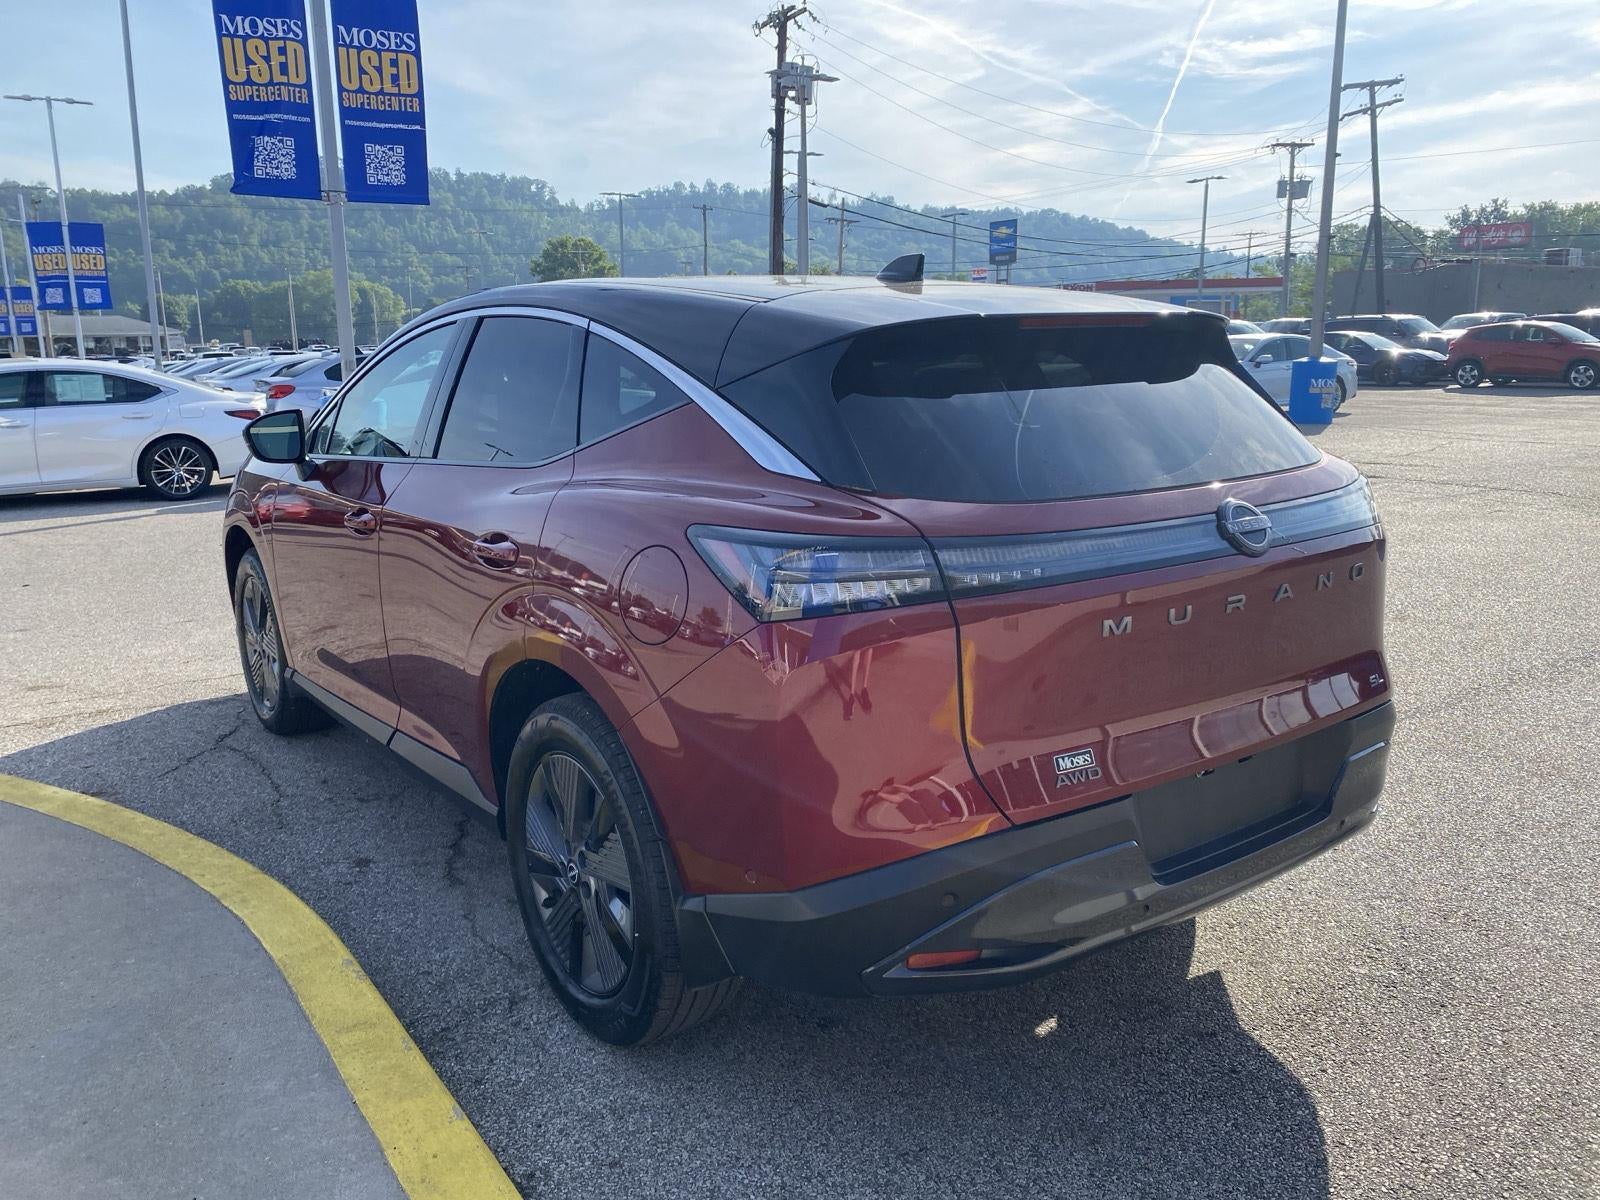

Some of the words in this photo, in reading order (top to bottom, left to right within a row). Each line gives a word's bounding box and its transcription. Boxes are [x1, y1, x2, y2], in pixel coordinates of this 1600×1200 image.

[219, 14, 303, 39] MOSES
[337, 25, 416, 51] MOSES
[221, 36, 307, 84] USED
[338, 47, 419, 94] USED
[229, 85, 309, 104] SUPERCENTER
[342, 92, 420, 112] SUPERCENTER
[71, 246, 104, 254] MOSES
[33, 253, 67, 270] USED
[72, 254, 105, 270] USED
[1102, 562, 1365, 637] MURANO
[1369, 673, 1384, 687] SL
[1058, 754, 1091, 770] MOSES
[1056, 767, 1102, 788] AWD
